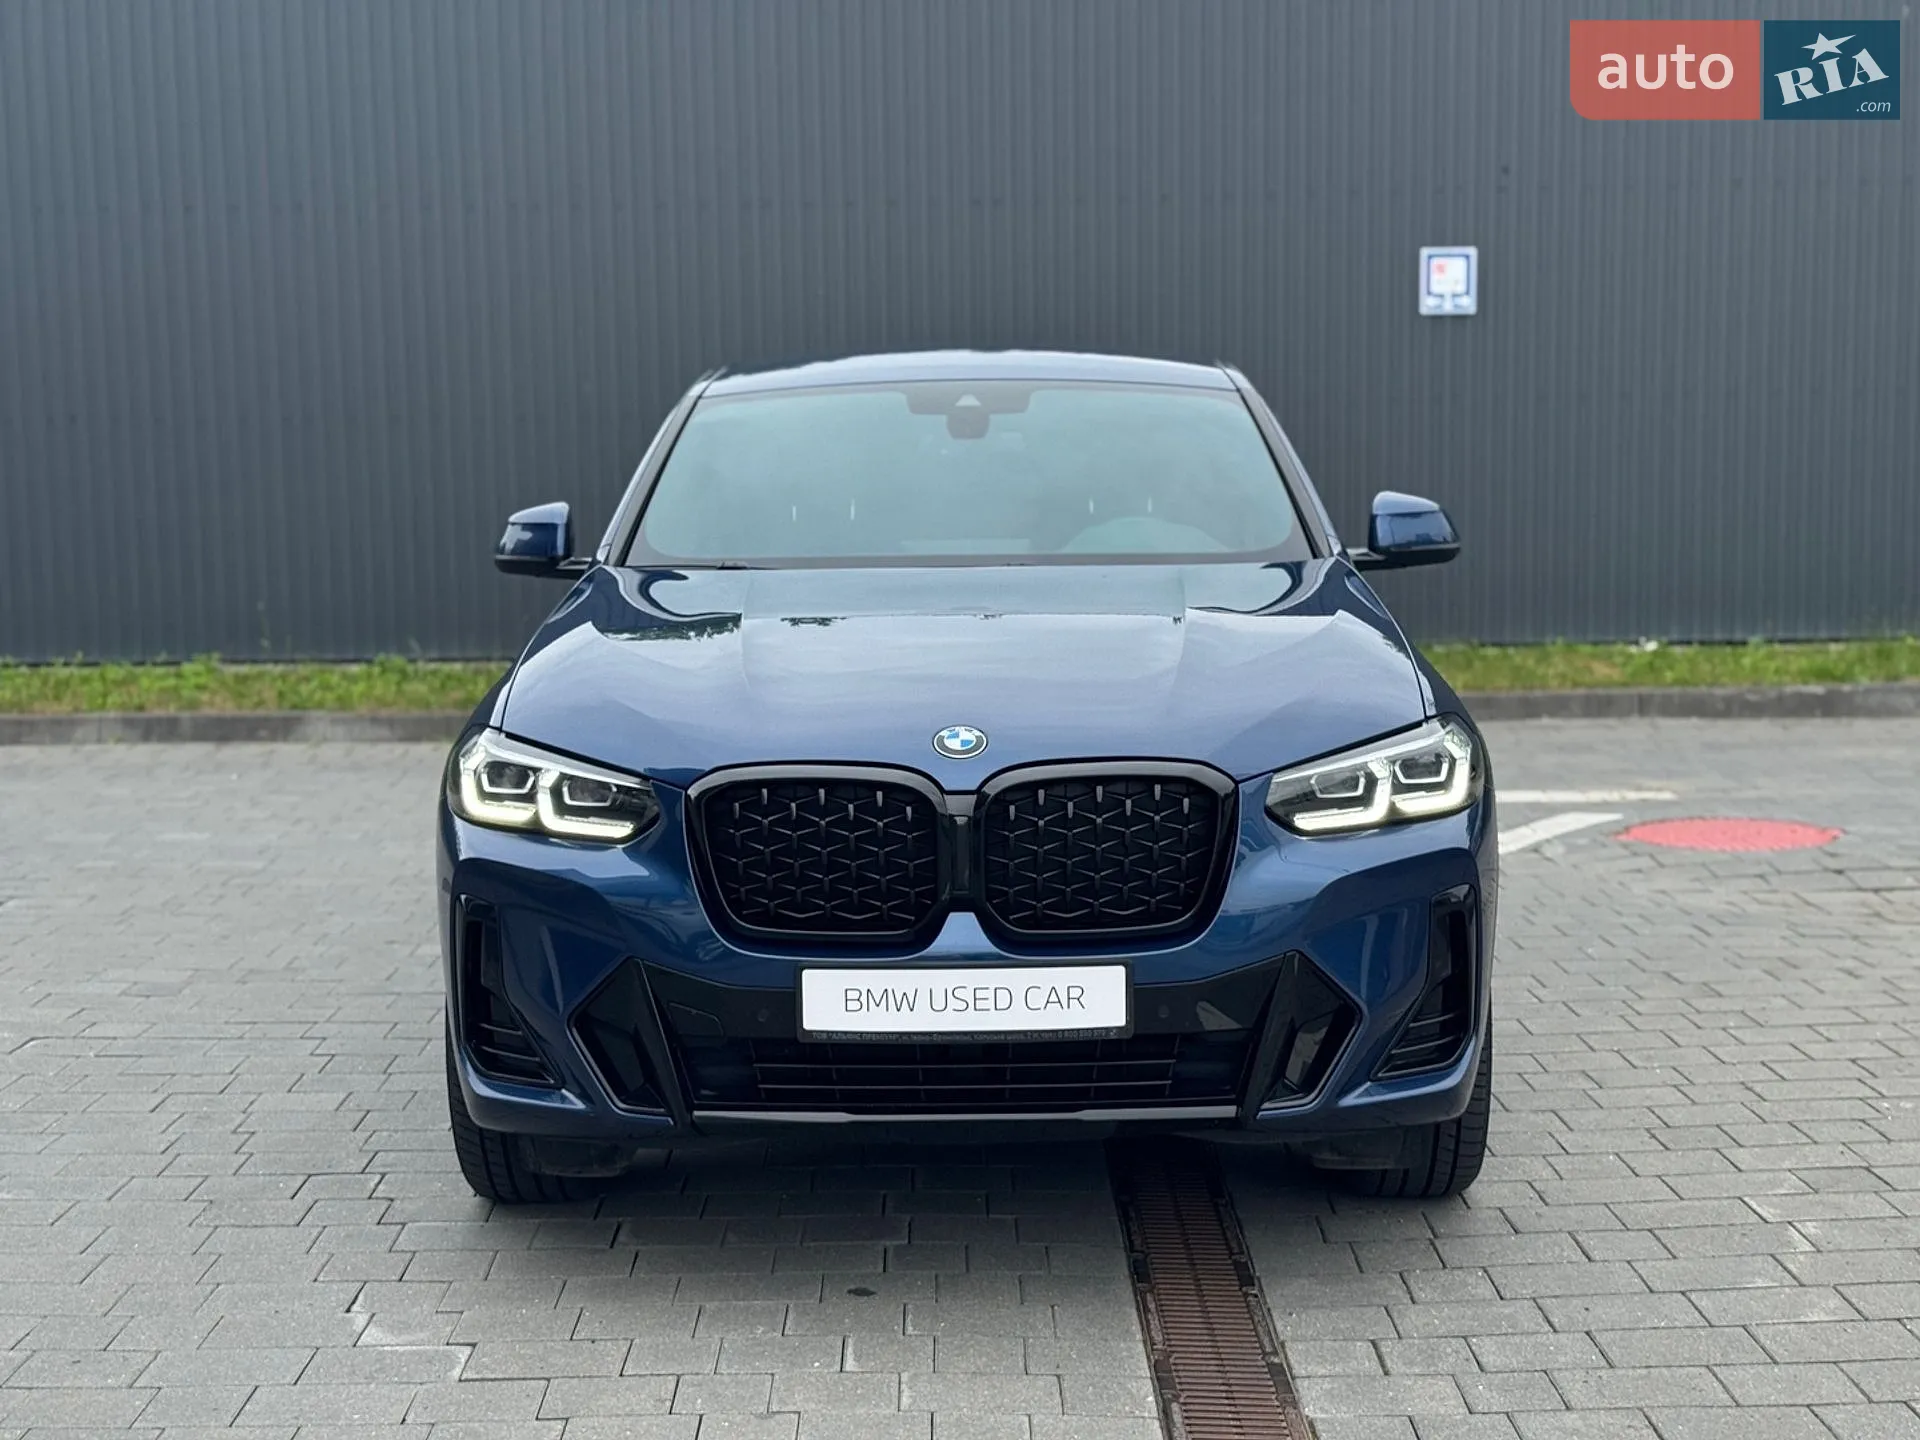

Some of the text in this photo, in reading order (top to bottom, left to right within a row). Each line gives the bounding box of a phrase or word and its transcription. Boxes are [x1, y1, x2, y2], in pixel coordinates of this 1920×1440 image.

[844, 984, 1086, 1013] BMW USED CAR
